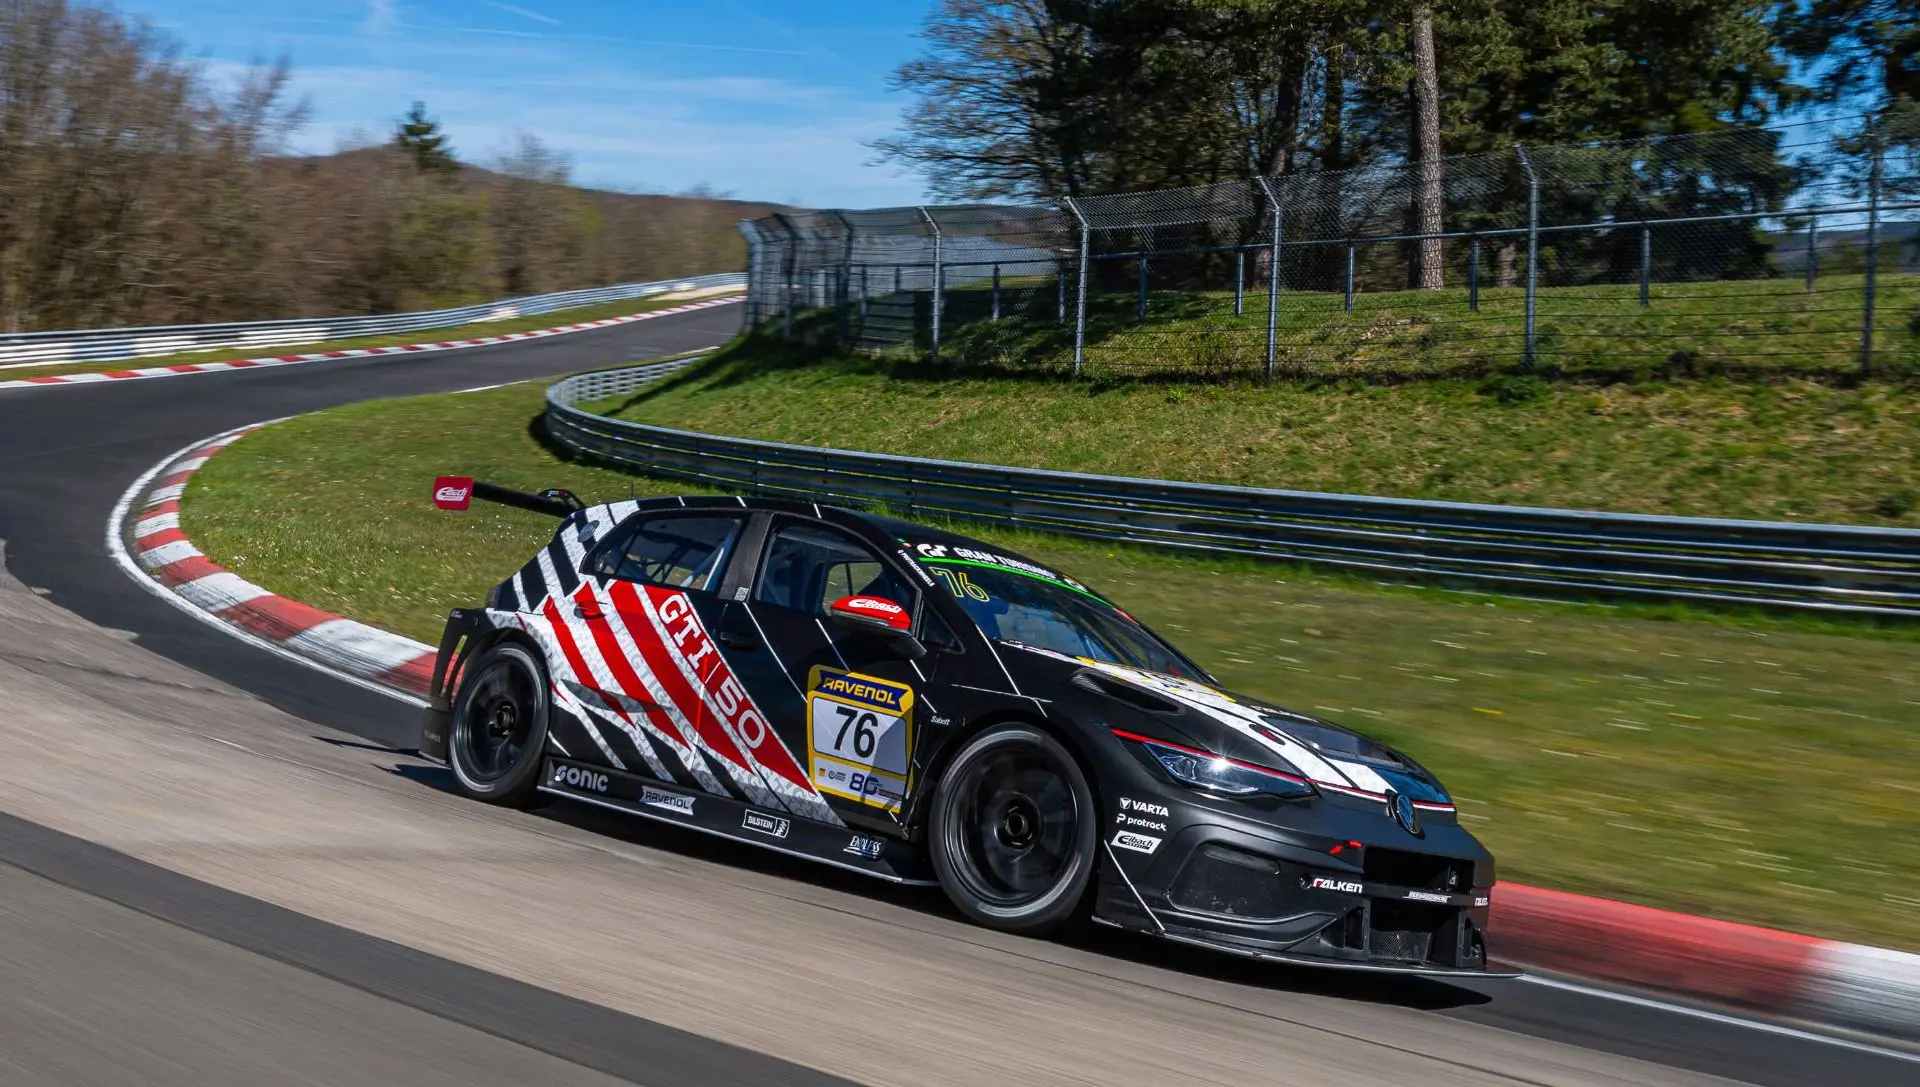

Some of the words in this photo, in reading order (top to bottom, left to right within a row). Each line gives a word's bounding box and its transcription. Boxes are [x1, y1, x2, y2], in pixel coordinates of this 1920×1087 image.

[953, 547, 997, 564] GRAN
[929, 566, 990, 602] 76
[659, 594, 714, 670] GTI
[715, 676, 766, 749] 50
[822, 677, 896, 705] RAVENOL
[834, 705, 879, 759] 76
[645, 790, 690, 809] RAVENOL
[1132, 799, 1169, 817] VARTA
[747, 815, 773, 829] BILSTEIN
[1127, 817, 1167, 832] protrack
[1117, 835, 1154, 850] Eibach
[1313, 877, 1363, 894] FALKEN
